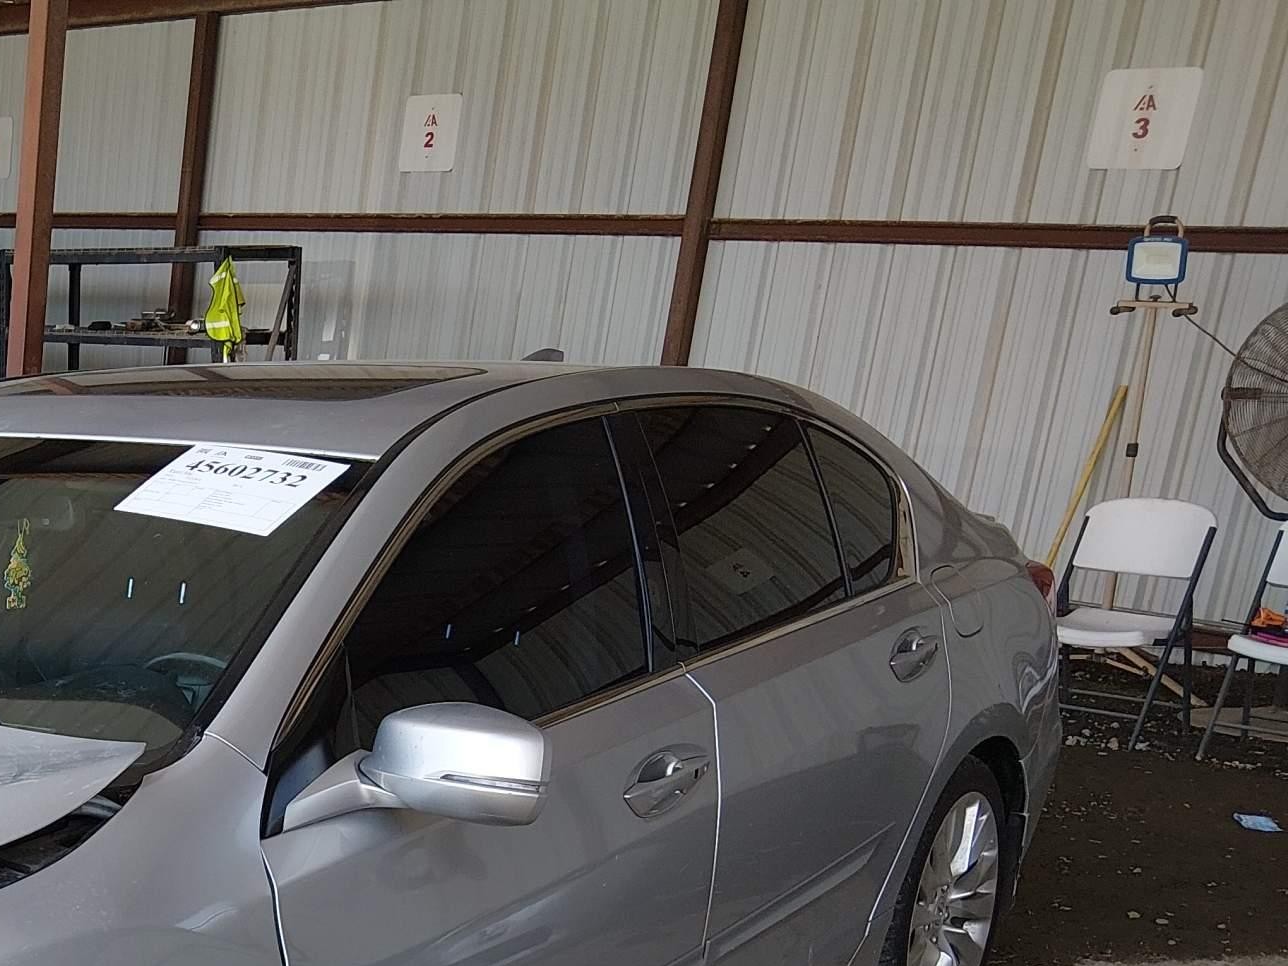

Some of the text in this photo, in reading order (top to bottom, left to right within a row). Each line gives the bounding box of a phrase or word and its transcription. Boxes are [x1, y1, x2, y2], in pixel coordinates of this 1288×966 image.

[423, 131, 435, 148] 2
[1132, 117, 1151, 140] 3
[185, 459, 307, 488] 45602732
